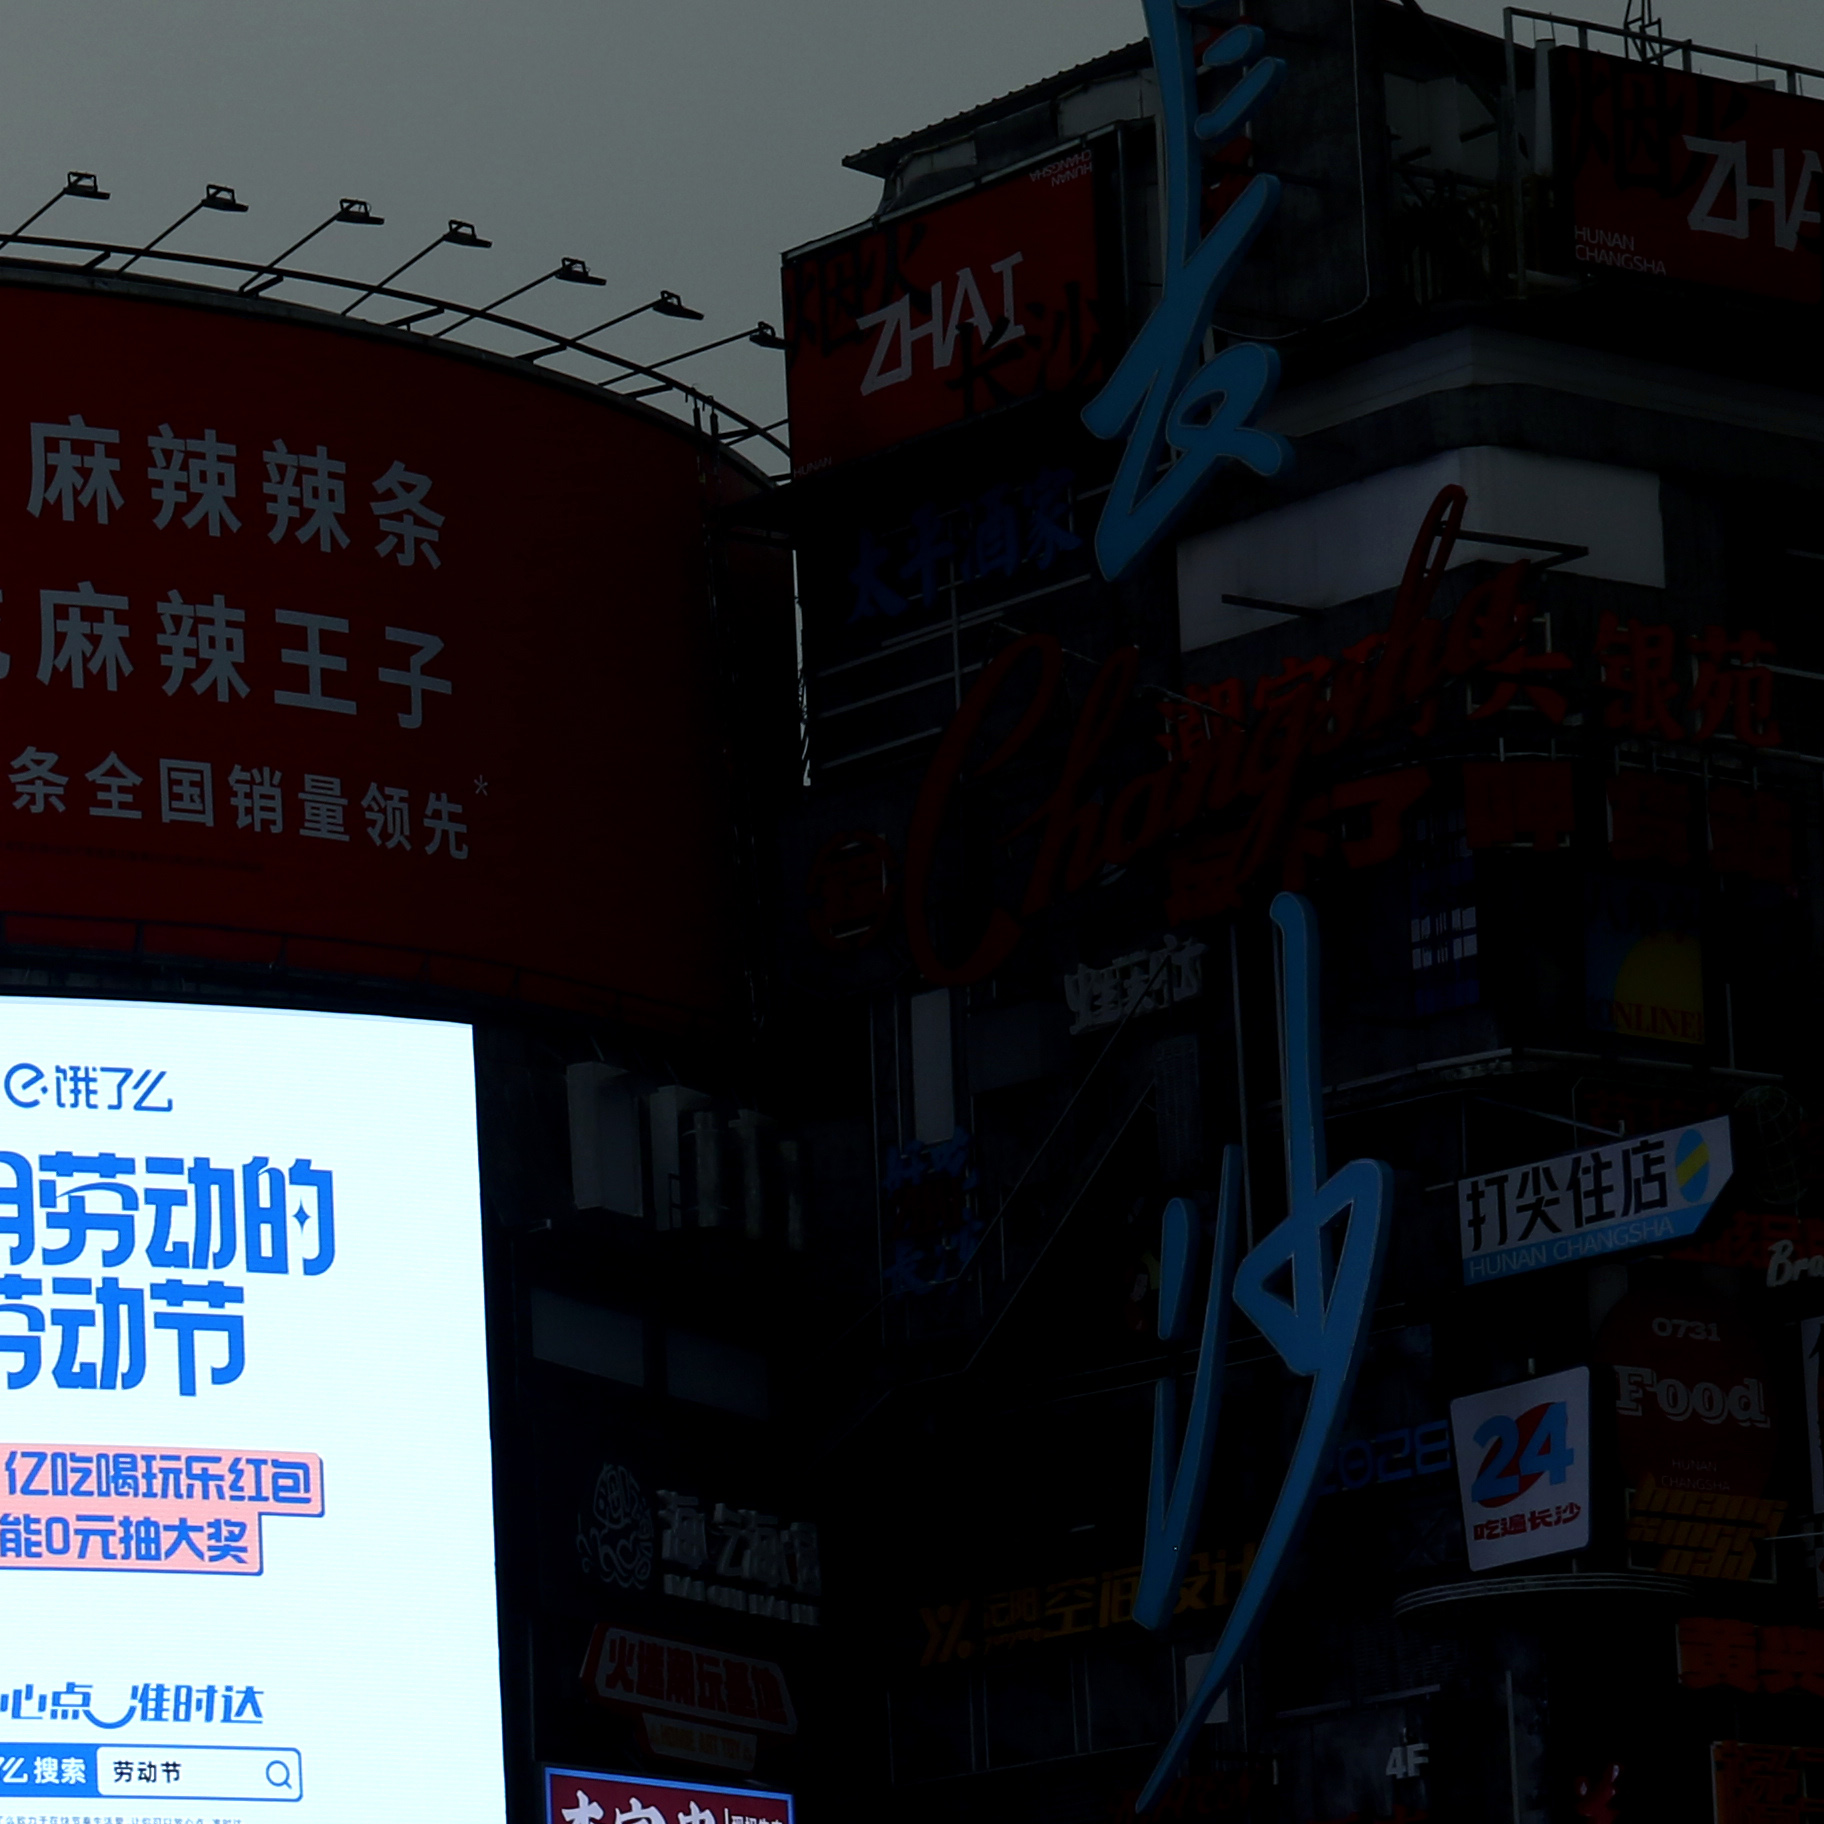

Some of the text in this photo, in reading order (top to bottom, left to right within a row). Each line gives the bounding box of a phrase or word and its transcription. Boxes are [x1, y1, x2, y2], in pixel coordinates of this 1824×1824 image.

[1573, 226, 1636, 250] HUNAN
[1573, 243, 1667, 277] CHANGSHA
[857, 251, 1027, 398] ZHAI
[794, 455, 833, 480] HUNAN
[846, 467, 1083, 626] 太平酒家
[1465, 1137, 1669, 1260] 打尖住店
[1468, 1244, 1548, 1280] HUNAN
[1552, 1213, 1676, 1260] CHANGSHA
[1652, 1316, 1721, 1343] 0731
[1612, 1364, 1771, 1428] Food
[1471, 1402, 1574, 1505] 24
[1671, 1458, 1718, 1473] HUNAN
[1661, 1474, 1731, 1493] CHANGSHA
[1473, 1501, 1581, 1541] 吃遍长沙
[34, 1756, 87, 1785] 搜索
[114, 1760, 182, 1783] 劳动节
[1386, 1742, 1430, 1780] 4F
